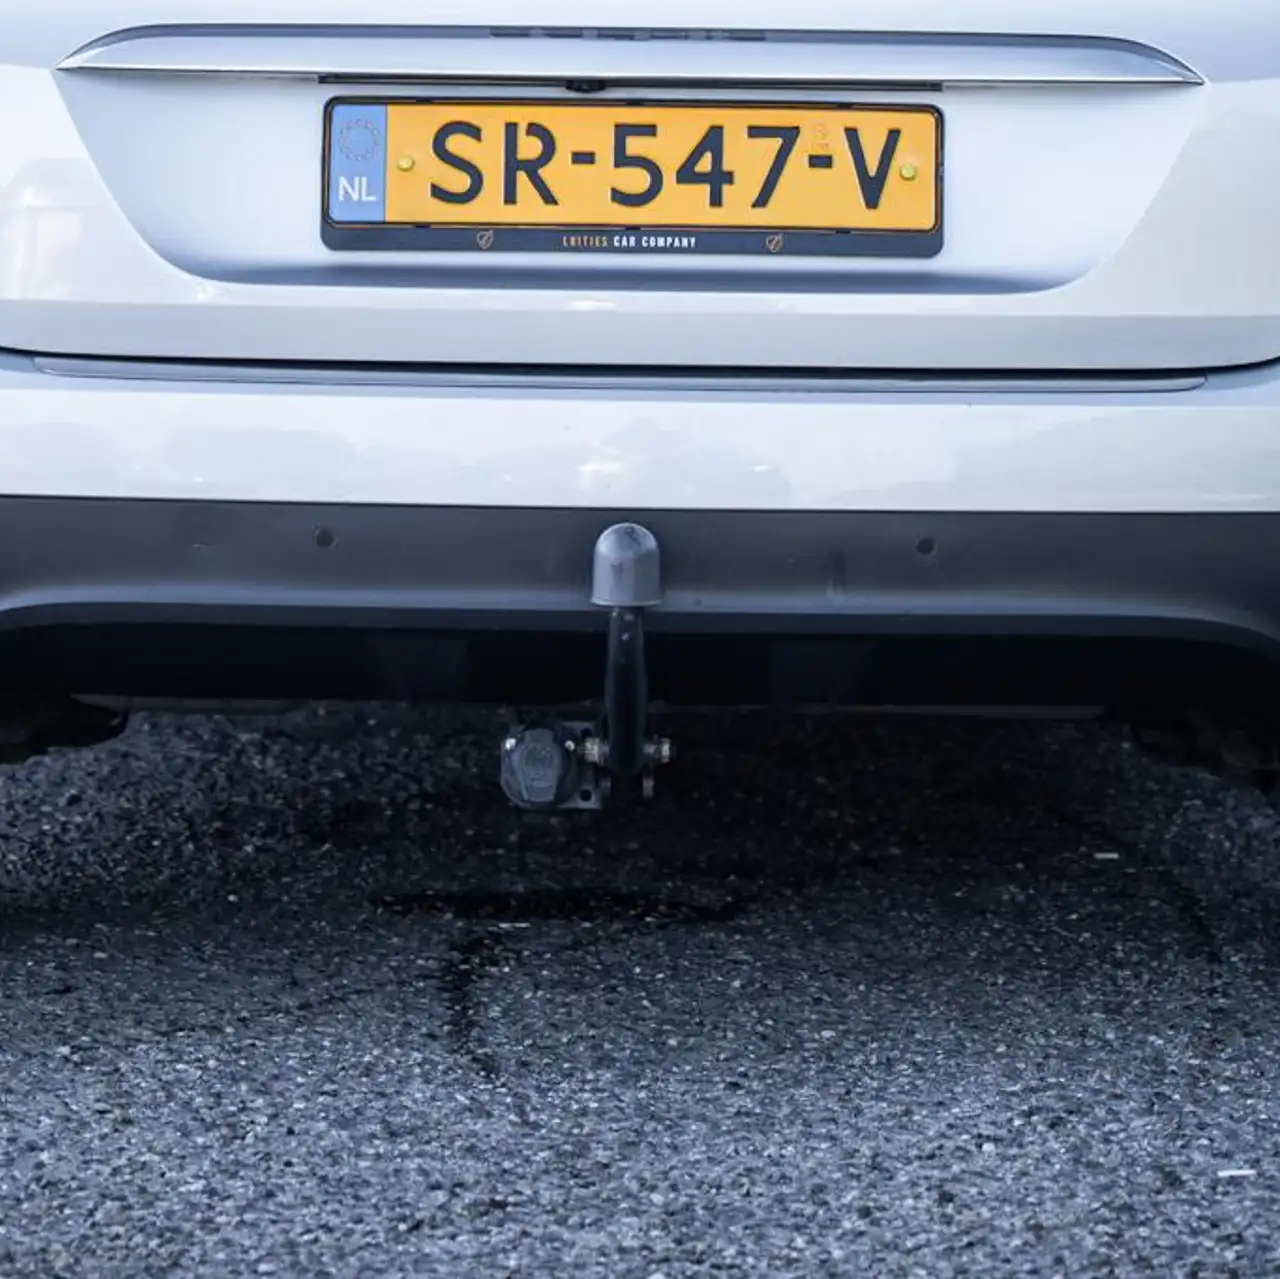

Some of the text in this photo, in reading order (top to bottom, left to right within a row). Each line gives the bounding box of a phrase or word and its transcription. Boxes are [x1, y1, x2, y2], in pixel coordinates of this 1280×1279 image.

[337, 119, 903, 210] NL SR-547-V
[613, 235, 637, 247] CAR
[641, 236, 696, 248] COMPANY
